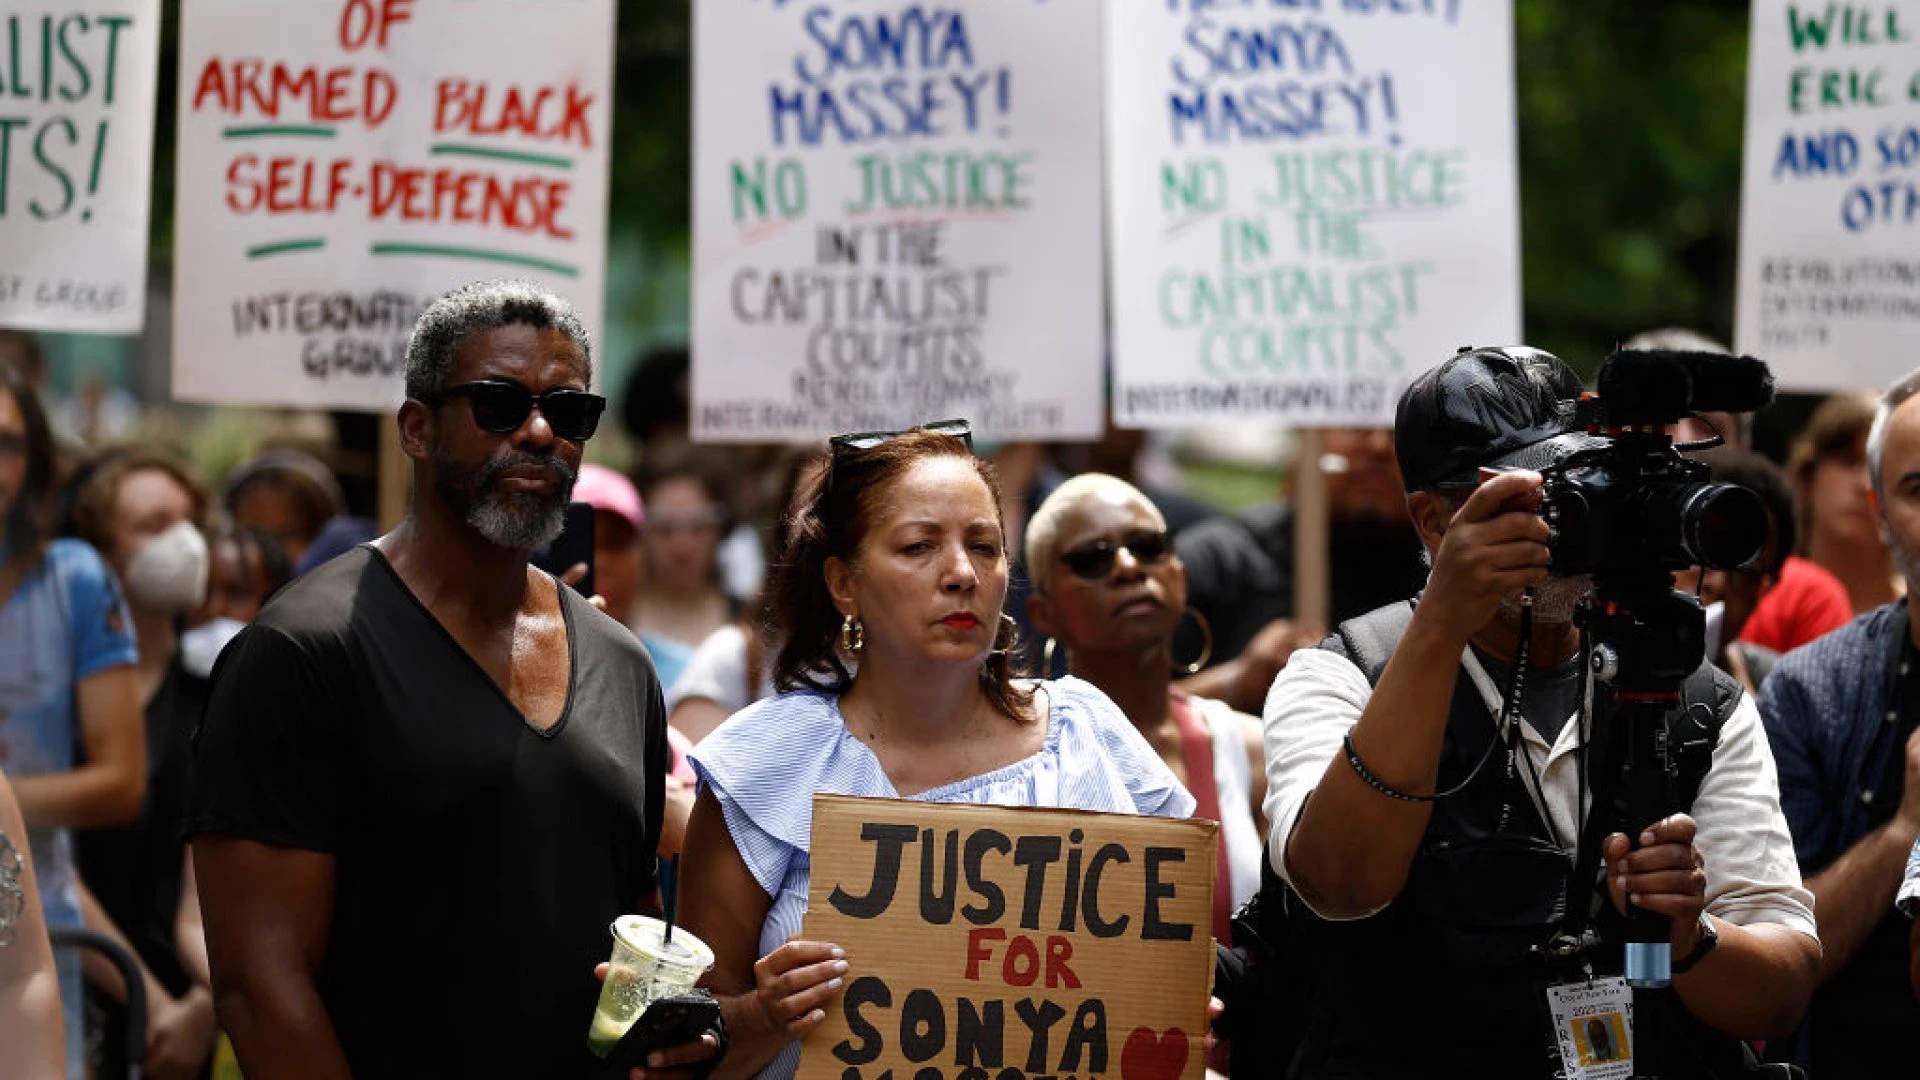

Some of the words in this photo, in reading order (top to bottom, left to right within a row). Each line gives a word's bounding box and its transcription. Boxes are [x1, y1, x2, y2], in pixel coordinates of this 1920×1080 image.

[0, 15, 132, 105] LIST
[796, 7, 973, 84] SONYA
[1171, 18, 1353, 90] SONYA
[1787, 5, 1906, 53] WILL
[193, 56, 397, 127] ARMED
[434, 77, 594, 150] BLACK
[769, 67, 1011, 145] MASSEY!
[1169, 70, 1402, 146] MASSEY!
[1790, 69, 1884, 112] ERIC
[730, 158, 807, 222] NO
[846, 150, 1032, 213] JUSTICE
[1160, 160, 1227, 211] NO
[1259, 150, 1465, 206] JUSTICE
[1773, 127, 1859, 180] AND
[817, 225, 857, 264] IN
[873, 224, 942, 265] THE
[1222, 216, 1270, 262] IN
[1294, 206, 1380, 260] THE
[965, 928, 1081, 989] FOR
[833, 977, 1108, 1074] SONYA
